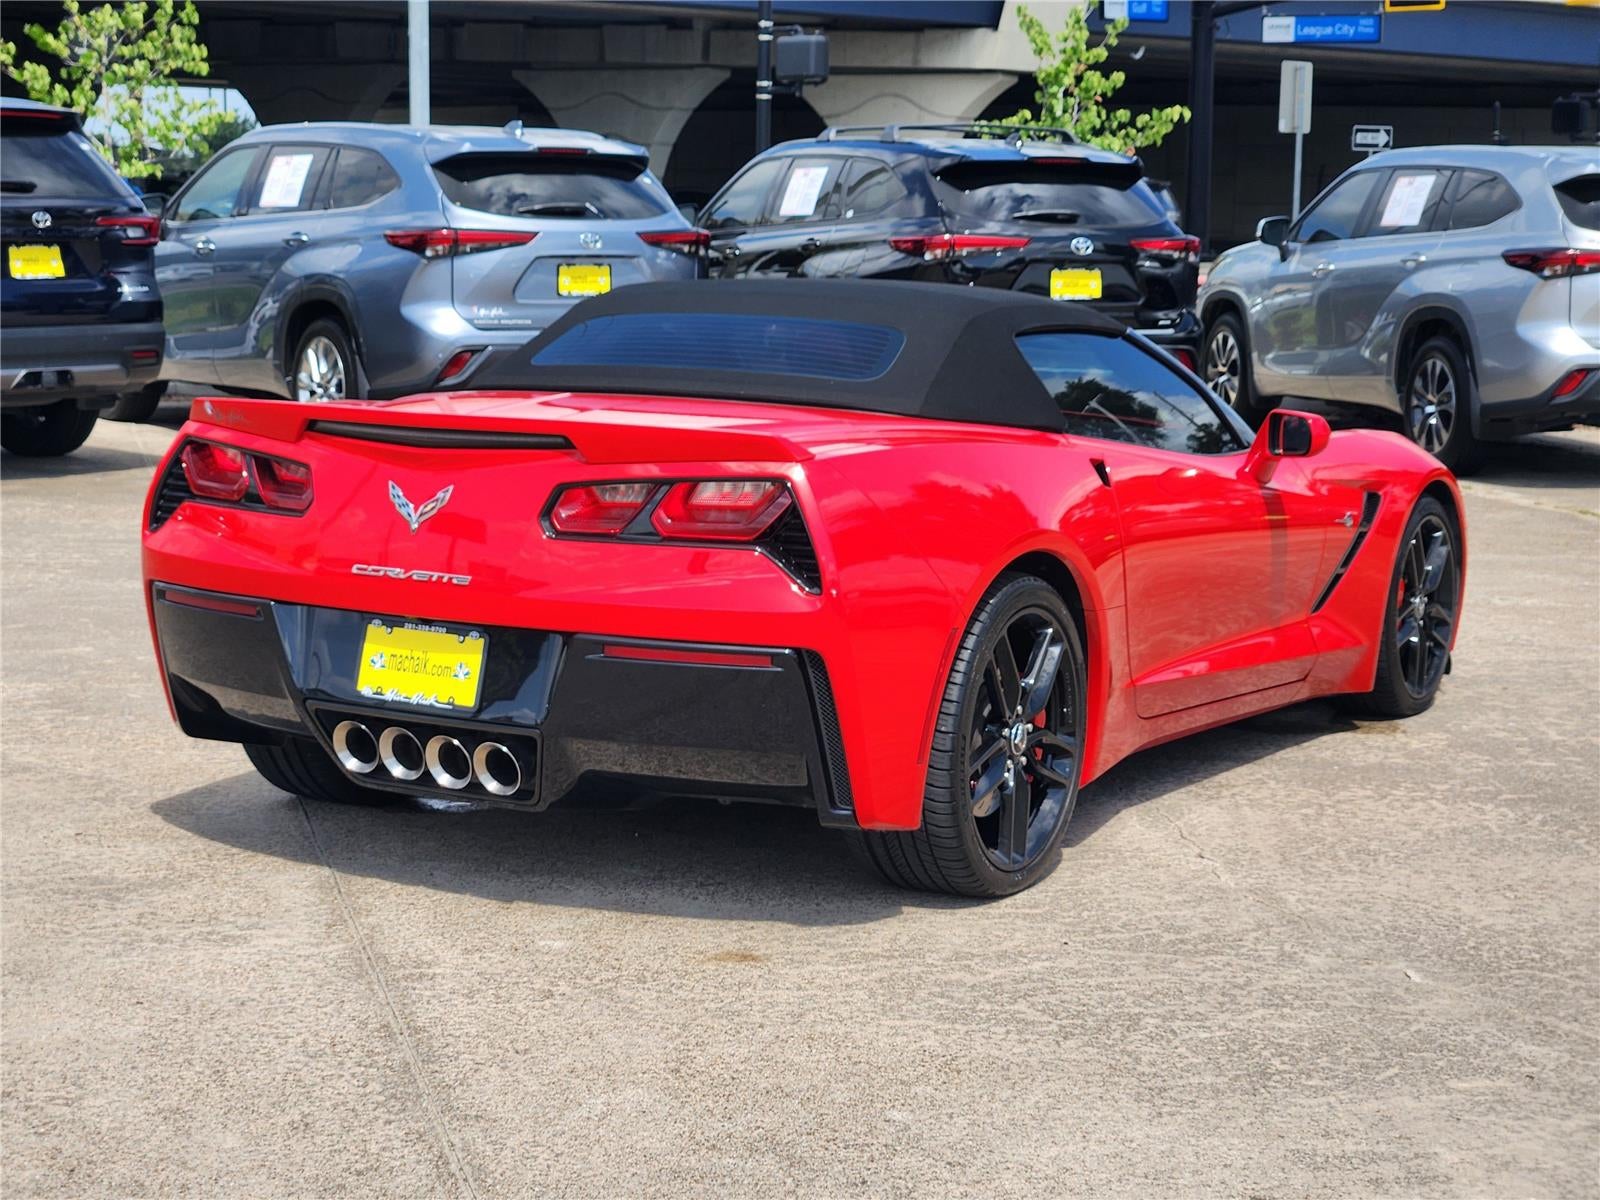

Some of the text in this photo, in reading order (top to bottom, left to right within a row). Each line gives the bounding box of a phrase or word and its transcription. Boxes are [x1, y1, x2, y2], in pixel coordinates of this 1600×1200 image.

[1297, 24, 1333, 38] League
[1334, 23, 1356, 36] City
[351, 563, 472, 585] CORVETTE
[388, 649, 452, 678] machaik.com
